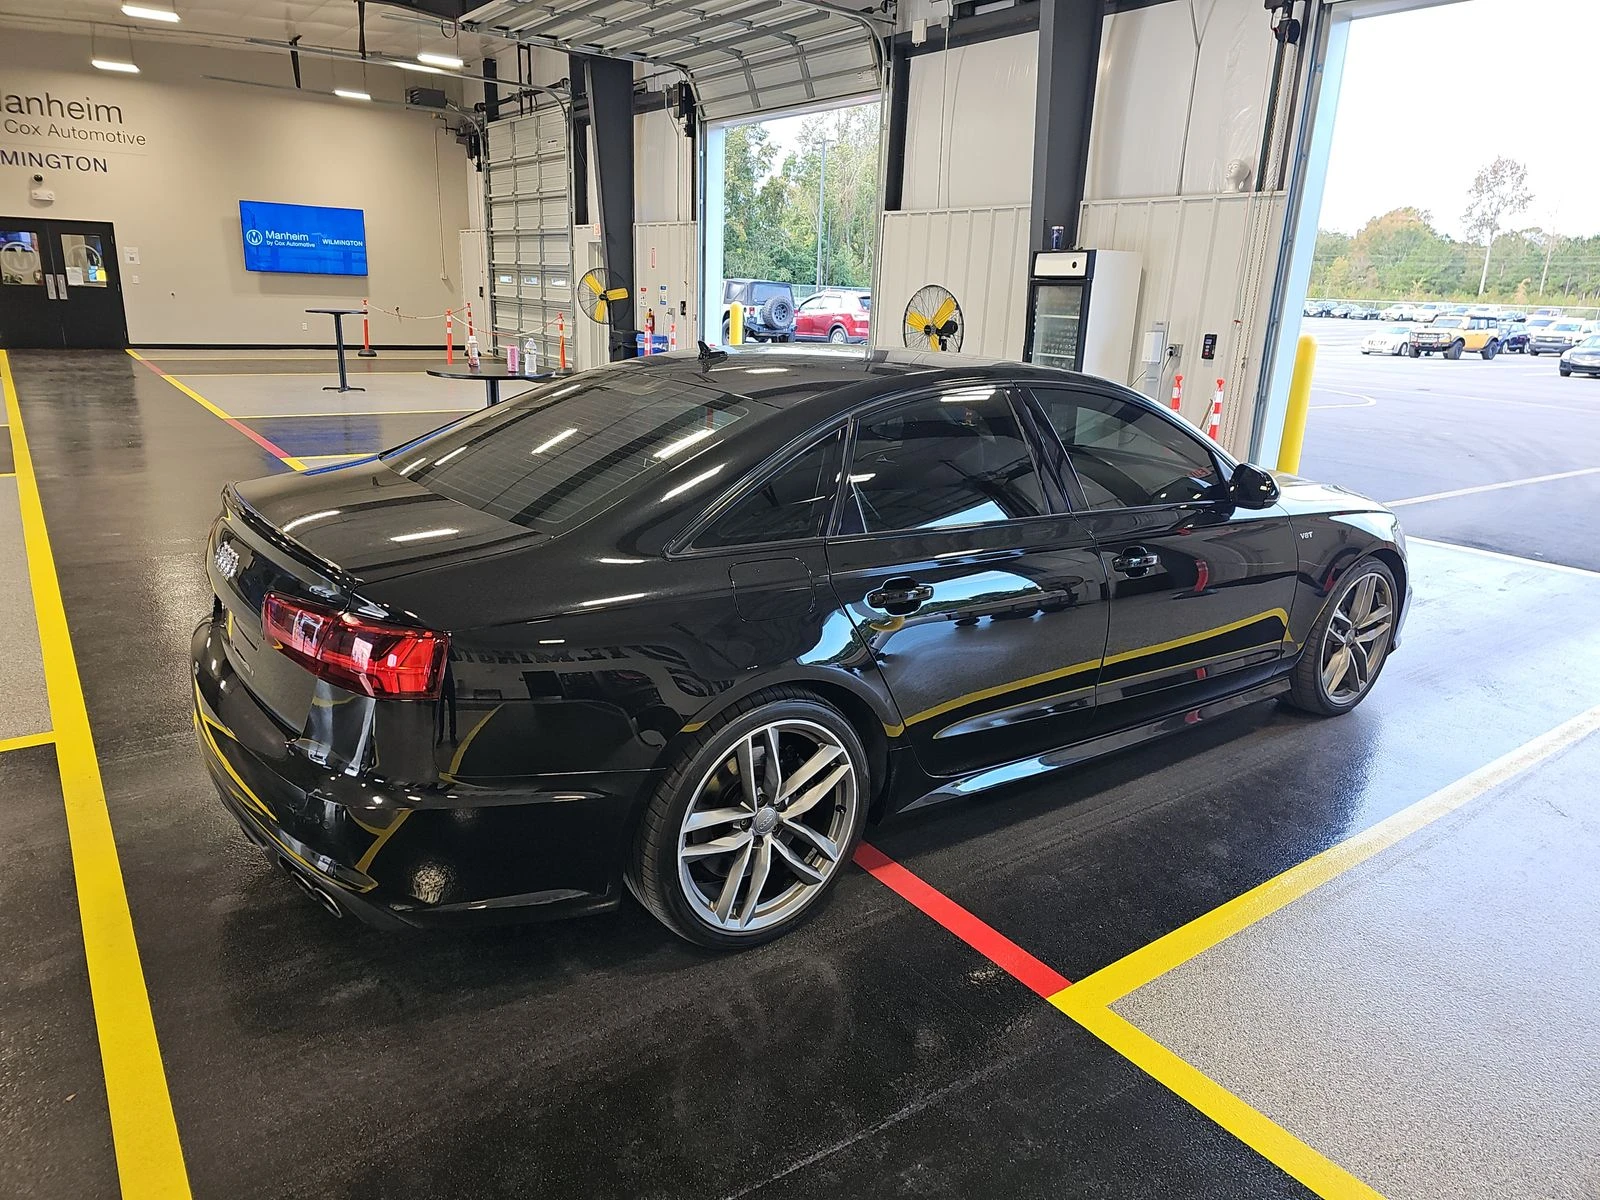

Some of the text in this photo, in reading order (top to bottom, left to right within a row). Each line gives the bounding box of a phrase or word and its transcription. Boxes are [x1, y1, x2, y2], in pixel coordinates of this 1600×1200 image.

[0, 89, 123, 124] anheim
[4, 119, 146, 146] Cox Automotive
[265, 230, 309, 241] Manheim
[322, 239, 363, 247] WILMINGTON
